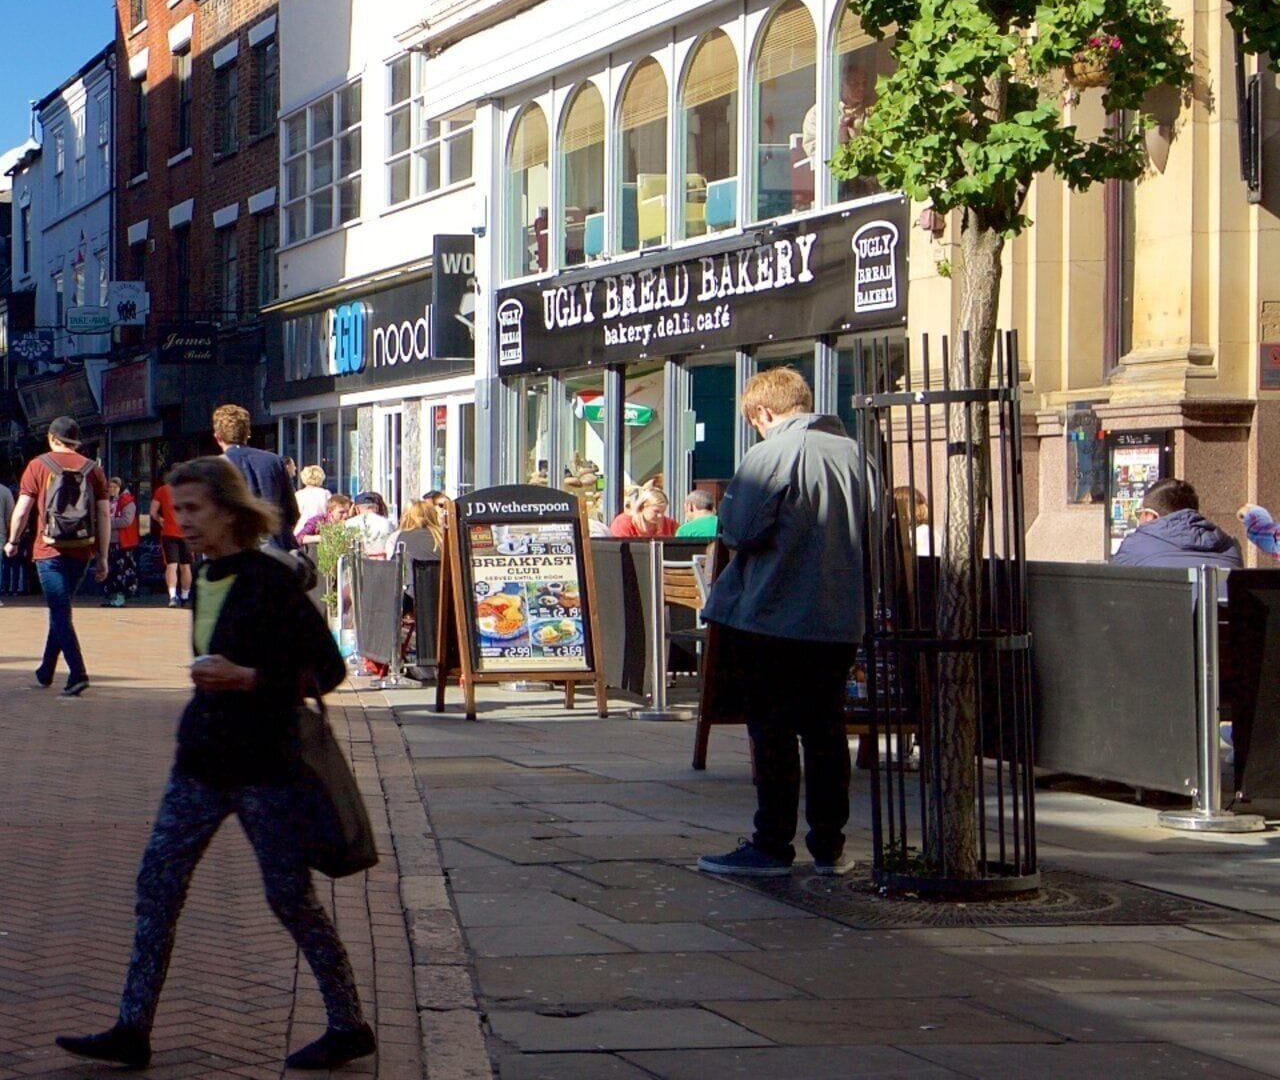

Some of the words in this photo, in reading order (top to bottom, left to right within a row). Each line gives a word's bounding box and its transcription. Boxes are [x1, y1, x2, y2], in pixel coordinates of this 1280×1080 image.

[859, 234, 891, 259] UGLY
[442, 253, 474, 274] WO
[542, 280, 596, 330] UGLY
[601, 263, 688, 319] BREAD
[696, 233, 817, 302] BAKERY
[858, 265, 893, 283] BREAD
[857, 287, 893, 305] BAKERY
[162, 333, 213, 351] James
[372, 303, 433, 368] noodl
[466, 502, 474, 517] J
[476, 502, 486, 514] D
[487, 501, 569, 516] Wetherspoon
[471, 556, 575, 568] BREAKFAST
[507, 567, 541, 575] CLUB
